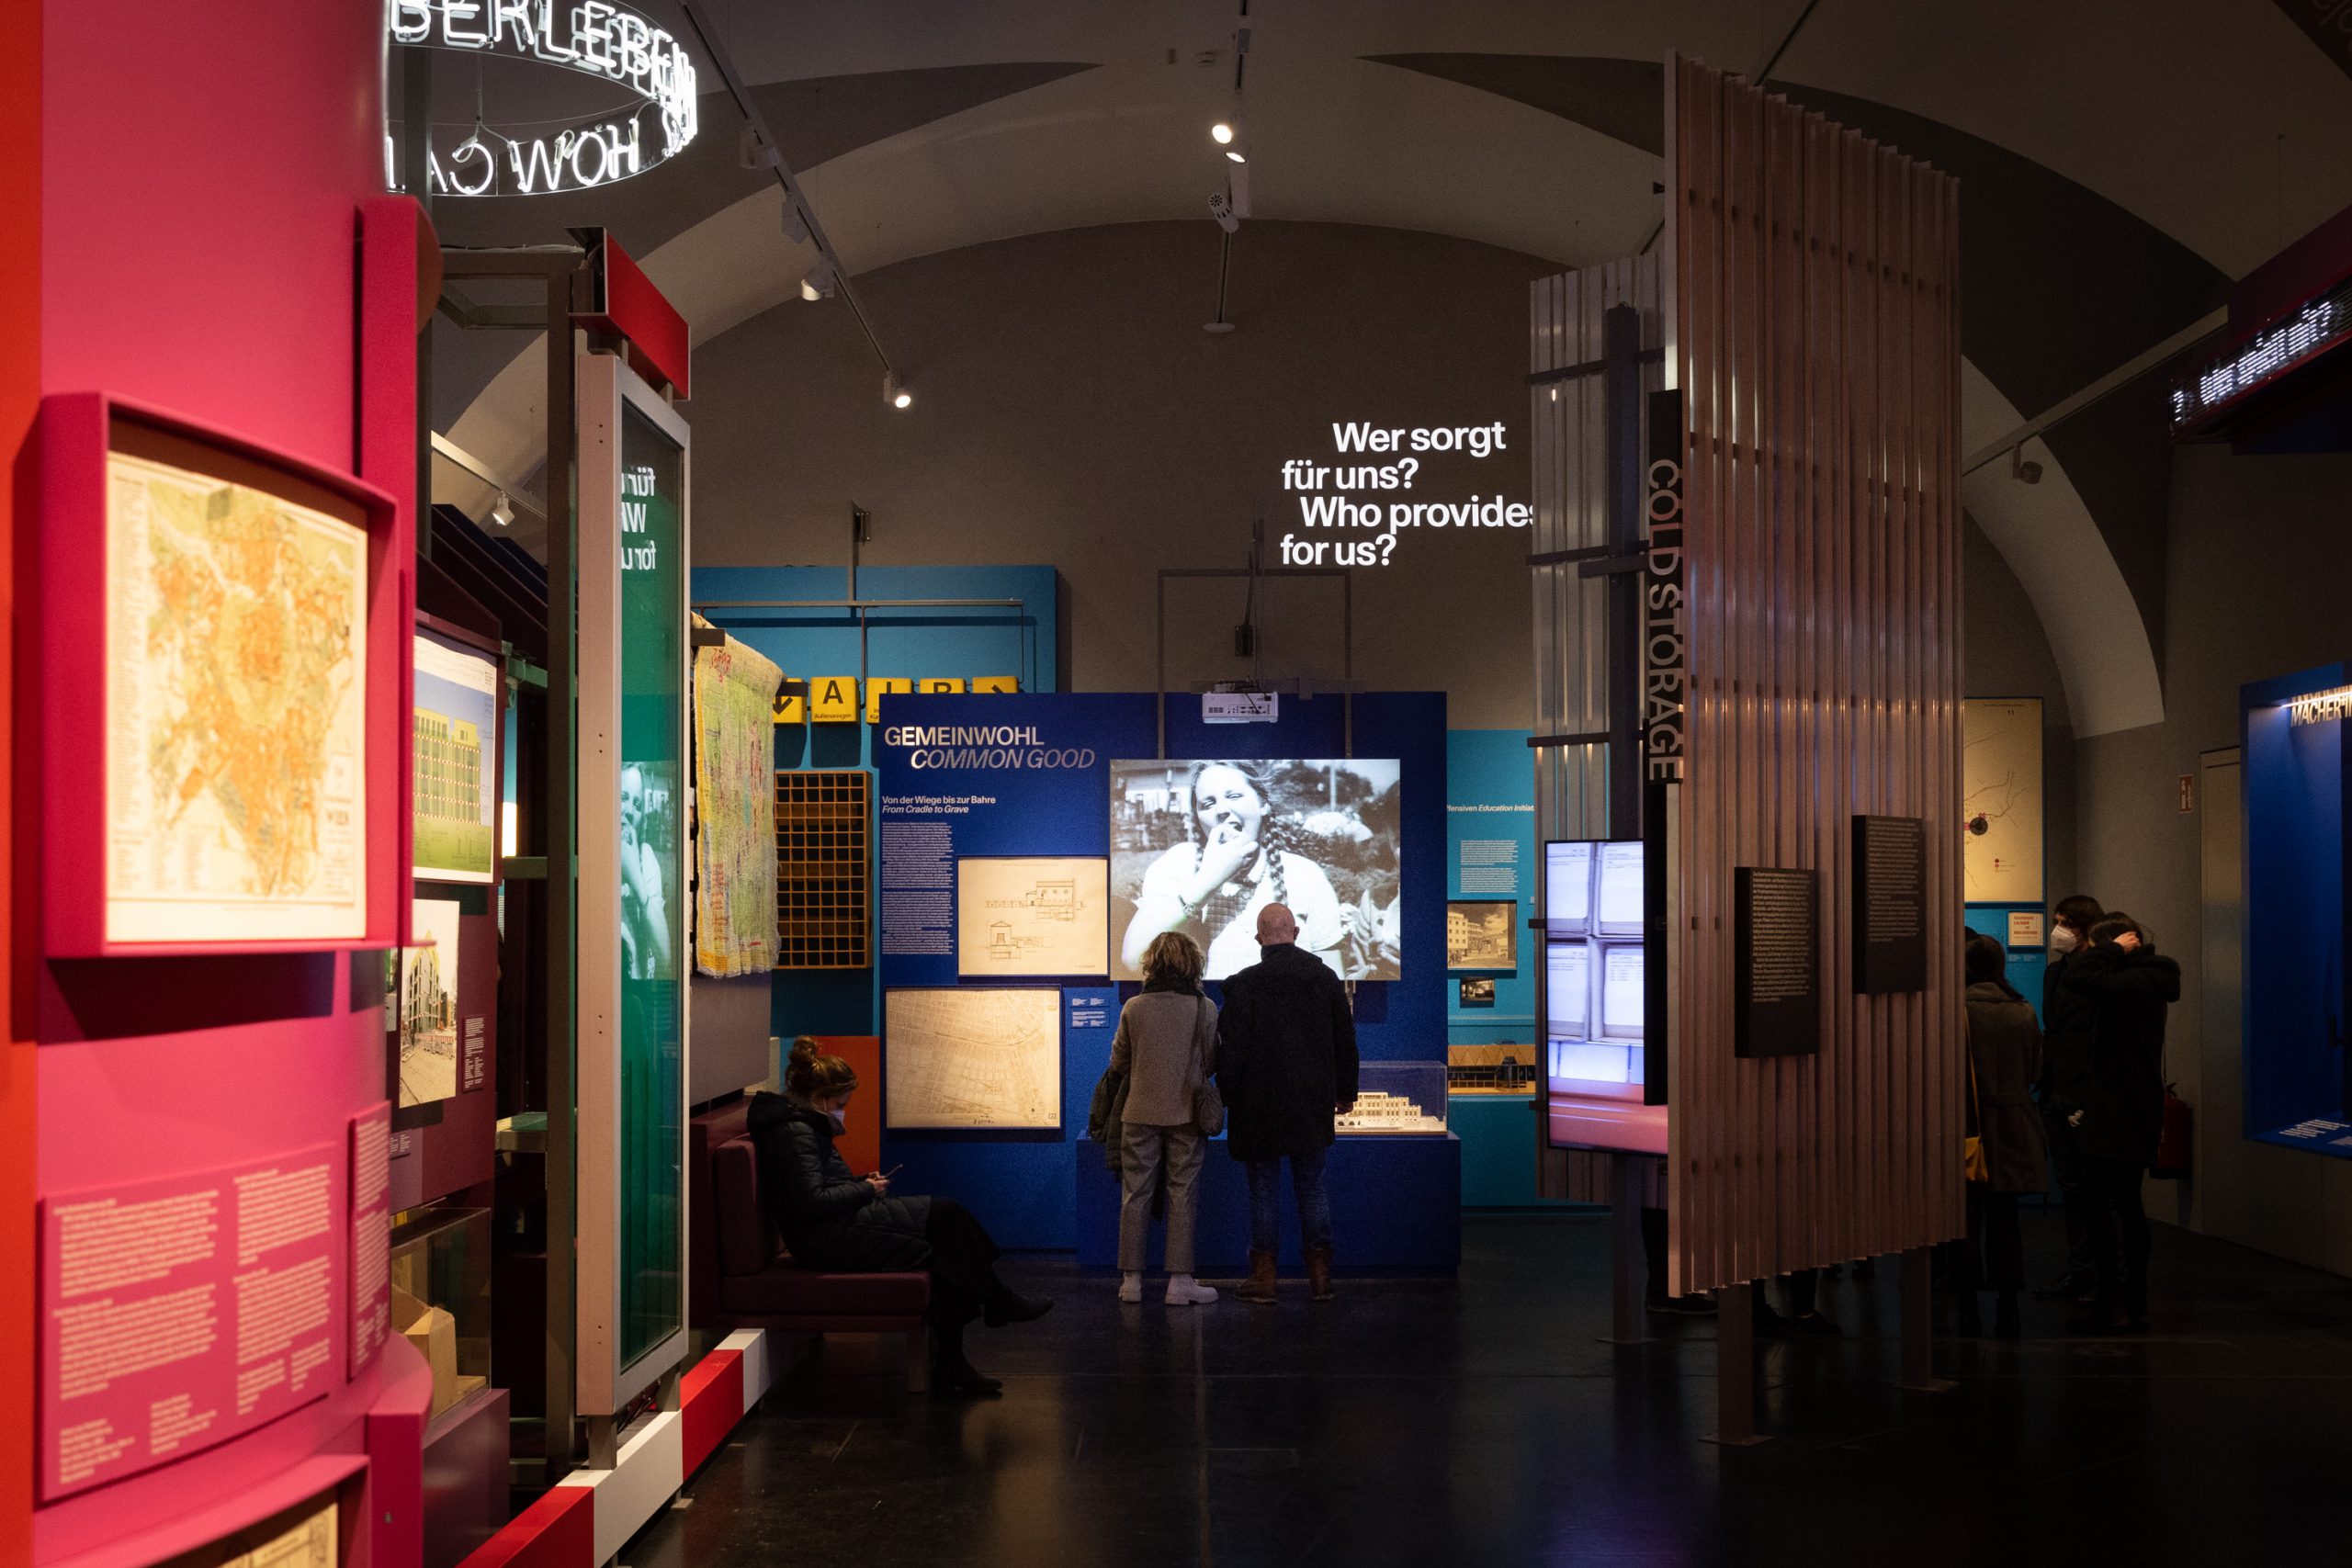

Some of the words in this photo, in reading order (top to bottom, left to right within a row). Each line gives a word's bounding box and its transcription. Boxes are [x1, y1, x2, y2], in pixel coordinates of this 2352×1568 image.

[1332, 422, 1406, 453] Wer
[1410, 421, 1507, 458] sorgt
[1282, 460, 1330, 491] für
[1335, 457, 1419, 490] uns?
[1300, 496, 1382, 527] Who
[1649, 458, 1679, 576] COLD
[1281, 533, 1329, 565] for
[1335, 534, 1397, 567] us?
[822, 680, 844, 705] A
[1649, 582, 1679, 781] STORAGE
[885, 727, 1044, 746] GEMEINWOHL
[910, 749, 1023, 769] COMMON
[1027, 749, 1095, 769] GOOD
[882, 795, 899, 805] Von
[899, 795, 914, 805] der
[915, 795, 942, 805] Wiege
[943, 795, 956, 805] bis
[971, 795, 996, 805] Bahre
[882, 805, 904, 814] From
[906, 805, 933, 814] Cradle
[934, 806, 943, 814] to
[944, 805, 969, 814] Grave
